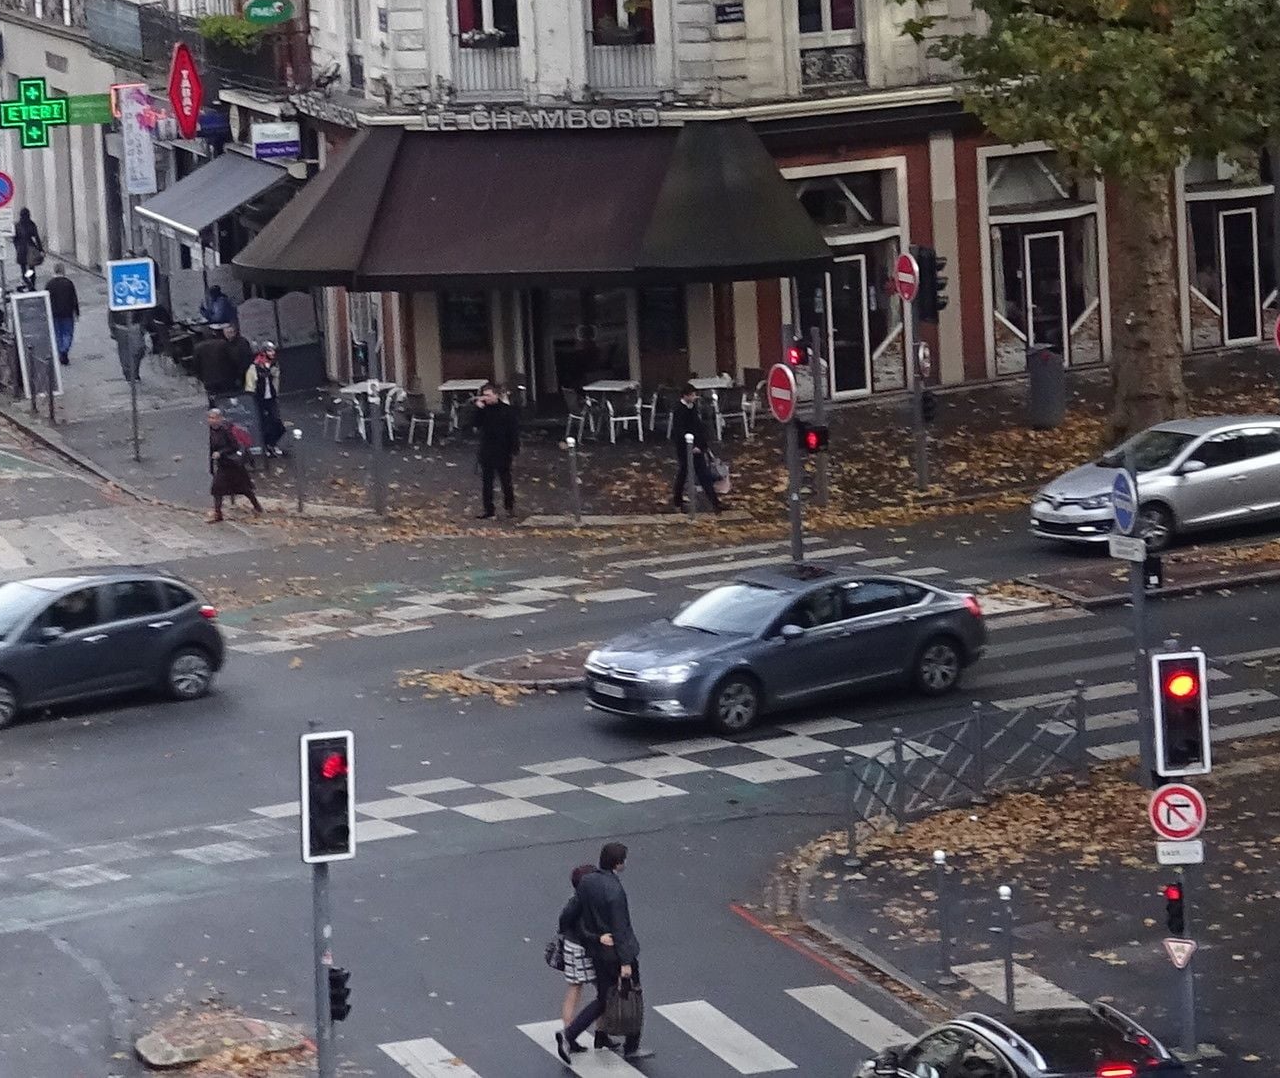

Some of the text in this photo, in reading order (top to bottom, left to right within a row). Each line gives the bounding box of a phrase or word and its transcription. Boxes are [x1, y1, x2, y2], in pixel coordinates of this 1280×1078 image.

[180, 69, 193, 116] TABAC
[421, 107, 660, 132] LE CHAMBORD
